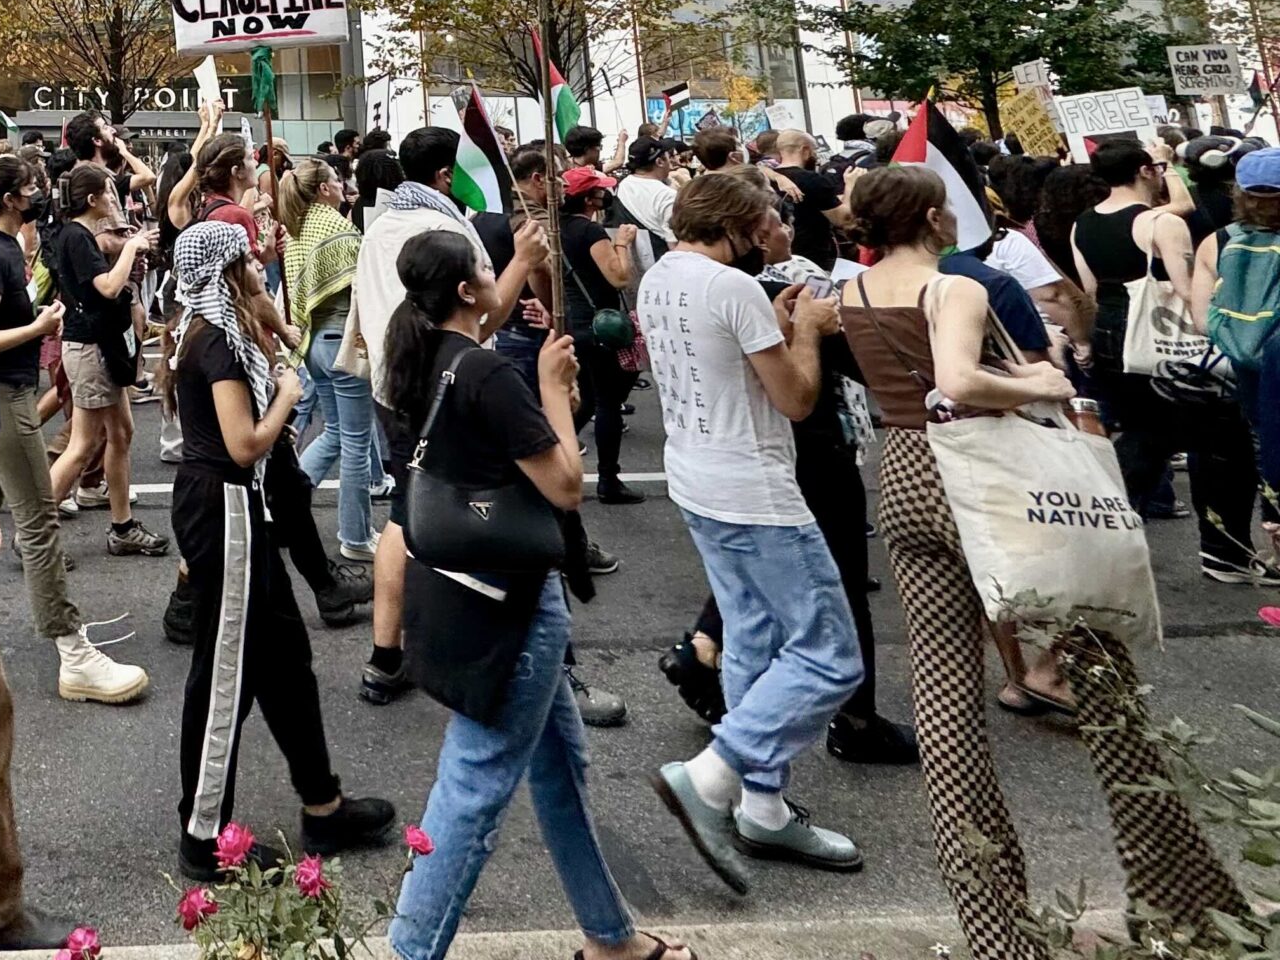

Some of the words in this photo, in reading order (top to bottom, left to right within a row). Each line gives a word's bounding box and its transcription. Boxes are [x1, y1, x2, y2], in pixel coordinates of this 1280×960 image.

[212, 13, 311, 38] NOW
[1175, 50, 1199, 63] CAN
[1202, 48, 1228, 62] YOU
[1016, 63, 1043, 85] LET
[1173, 64, 1200, 77] HEAR
[1202, 64, 1232, 75] GAZA
[33, 86, 110, 108] CITY
[1059, 90, 1150, 134] FREE
[140, 129, 188, 137] STREET
[1026, 491, 1082, 508] YOU
[1091, 496, 1127, 512] ARE
[1026, 508, 1120, 530] NATIVE
